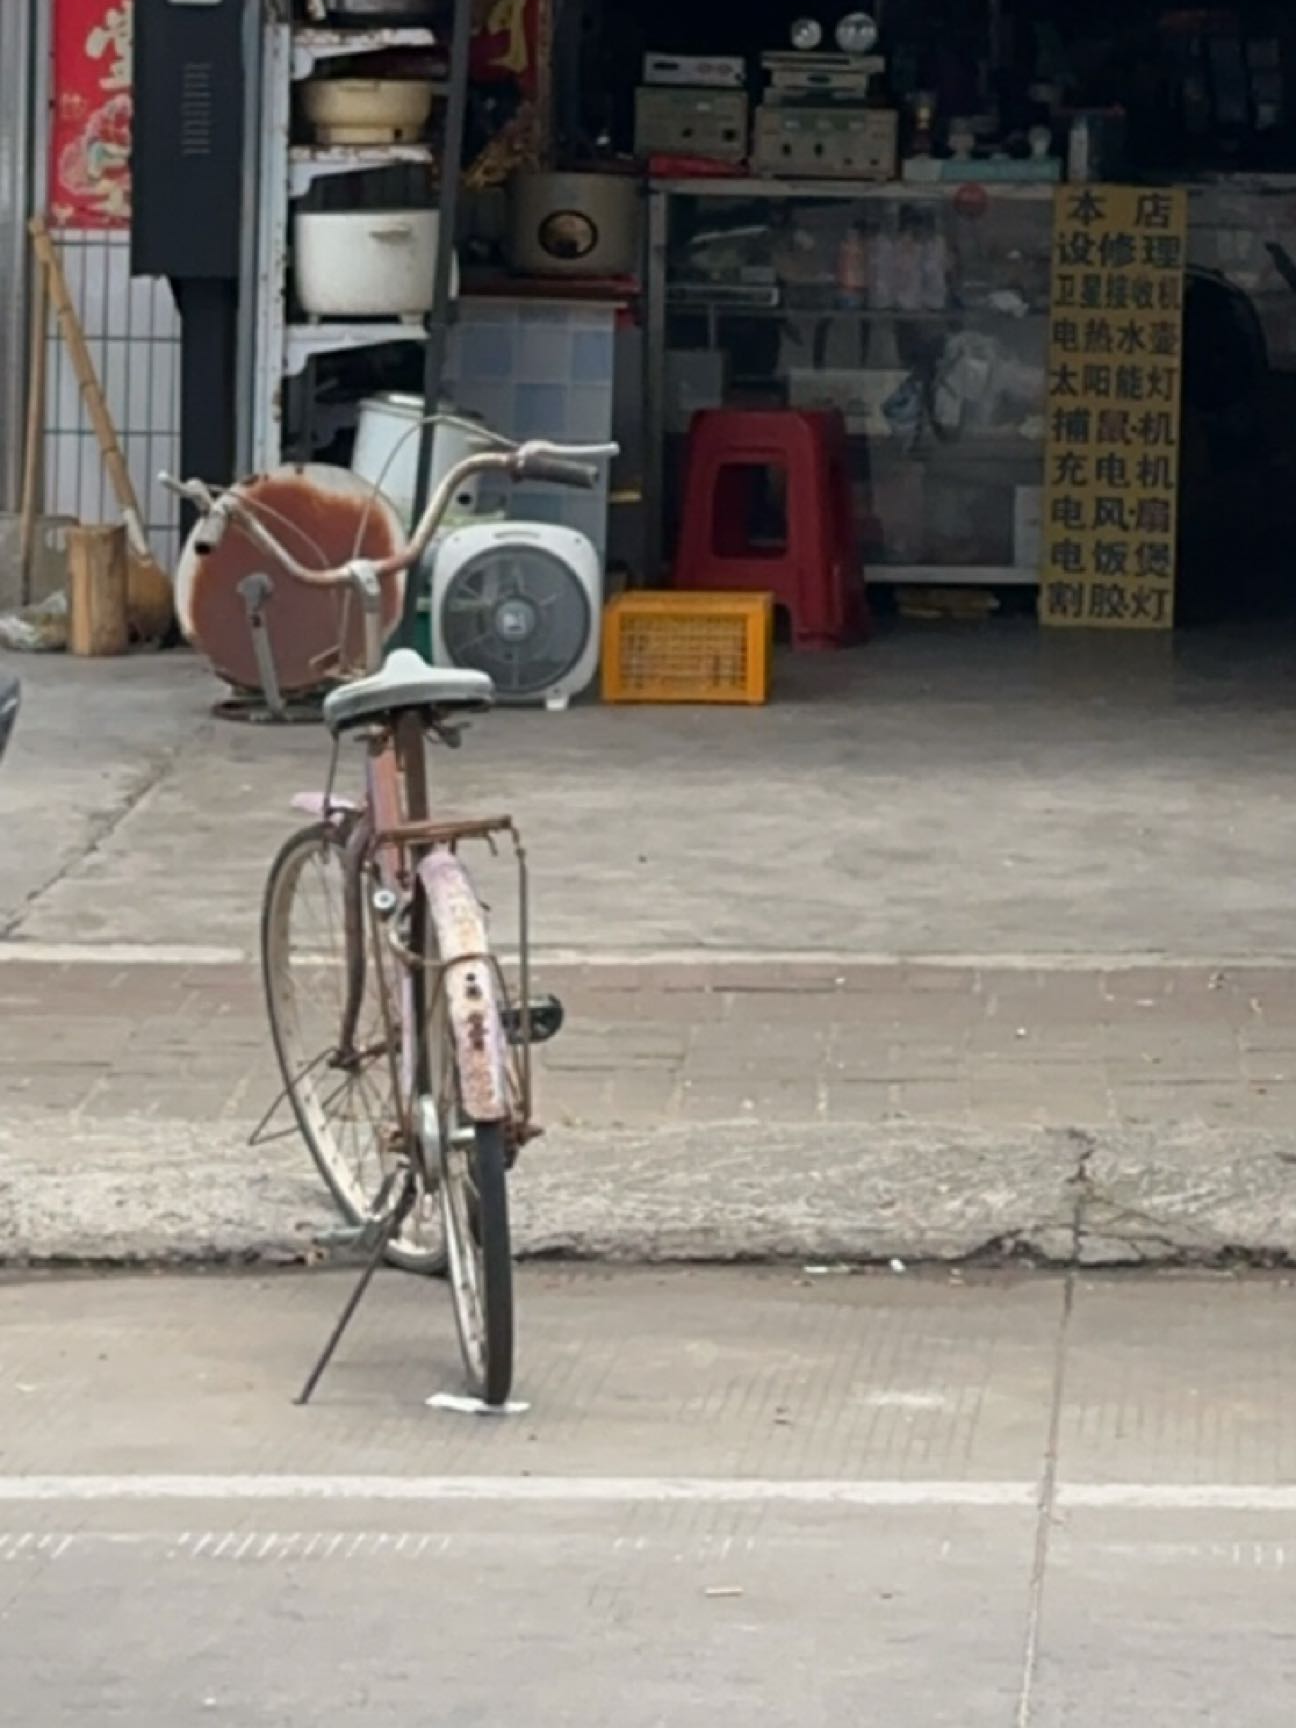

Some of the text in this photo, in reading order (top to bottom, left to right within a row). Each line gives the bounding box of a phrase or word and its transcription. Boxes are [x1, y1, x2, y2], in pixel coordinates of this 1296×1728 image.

[1058, 235, 1182, 270] 设修理
[1053, 275, 1181, 311] 卫星接收机
[1053, 320, 1178, 355] 电热水壶
[1050, 366, 1176, 401] 太阳能灯
[1052, 454, 1173, 489] 充电机
[1051, 542, 1170, 578] 电饭煲
